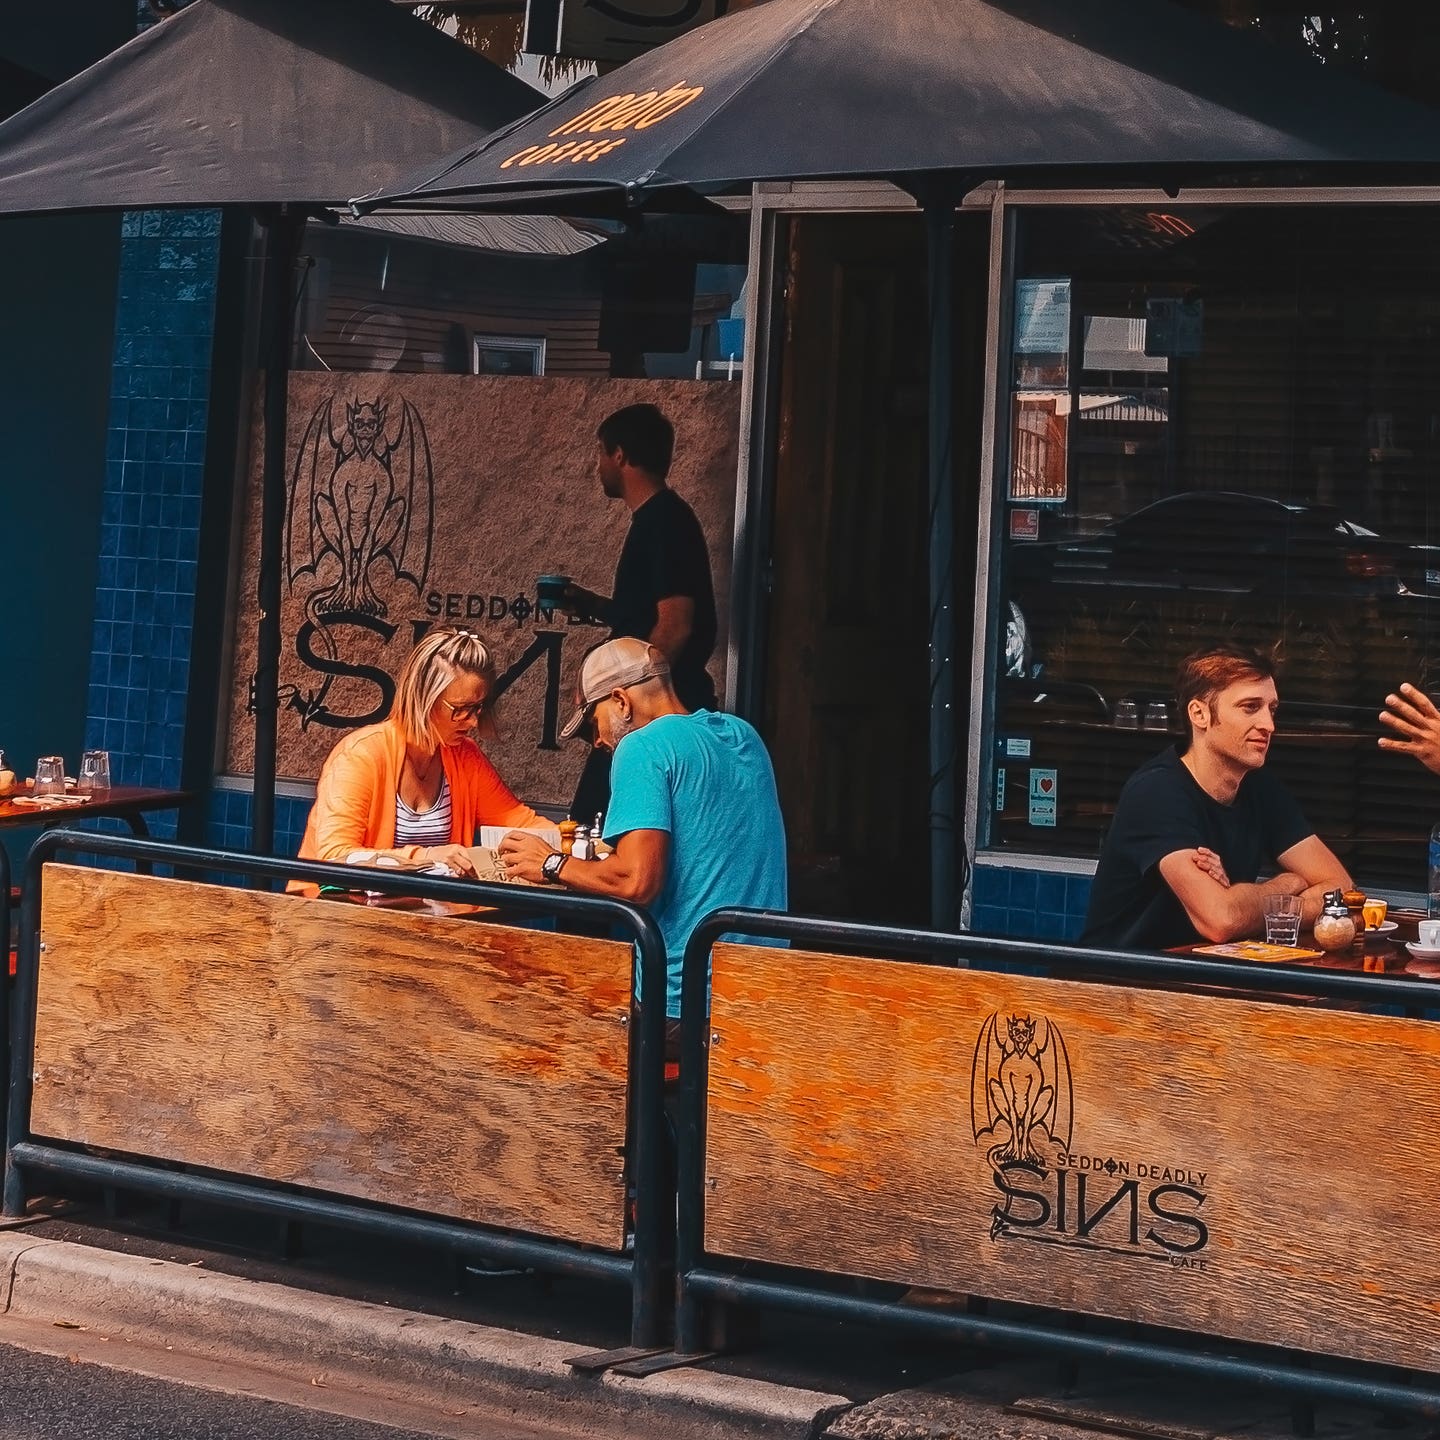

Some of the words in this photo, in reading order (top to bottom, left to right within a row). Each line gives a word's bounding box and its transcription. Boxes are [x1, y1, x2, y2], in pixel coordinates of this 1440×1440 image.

[547, 79, 705, 138] metro
[499, 137, 628, 170] COFFEE
[425, 590, 555, 628] SEDDON
[1055, 1152, 1131, 1178] SEDDON
[1137, 1163, 1210, 1187] DEADLY
[1170, 1254, 1209, 1272] CAFE
